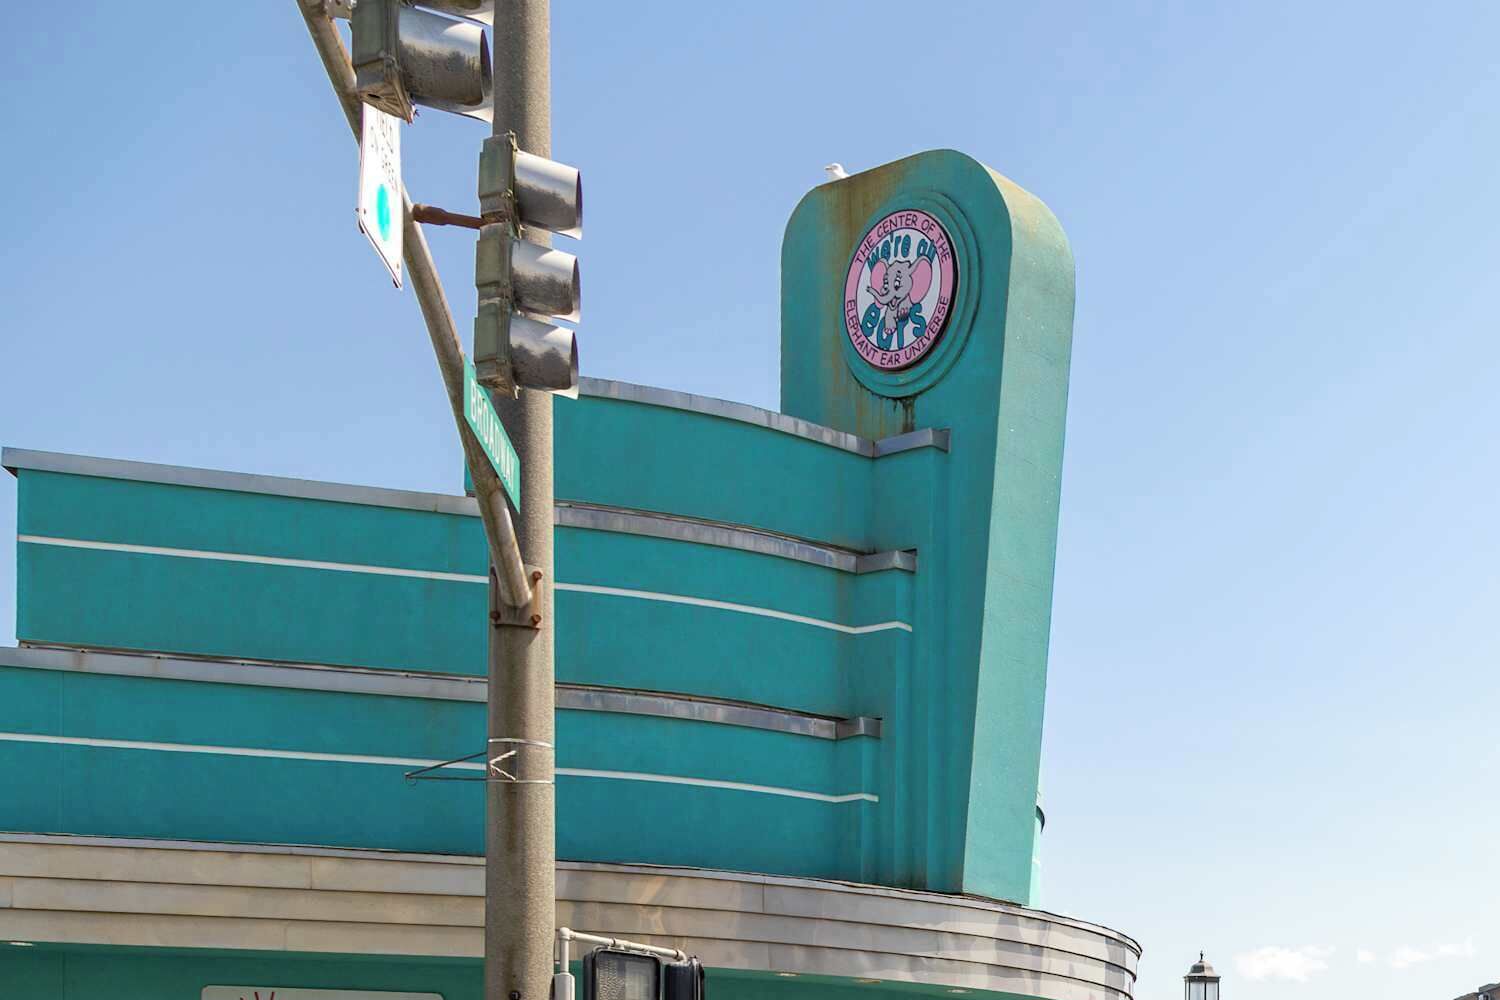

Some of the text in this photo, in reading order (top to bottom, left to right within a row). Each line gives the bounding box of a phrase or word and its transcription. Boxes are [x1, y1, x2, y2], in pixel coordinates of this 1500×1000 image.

[854, 214, 950, 265] THE CENTER OF THE
[846, 297, 949, 367] ELEPHANT EAR UNIVERSE
[470, 377, 515, 492] BROADWAY
